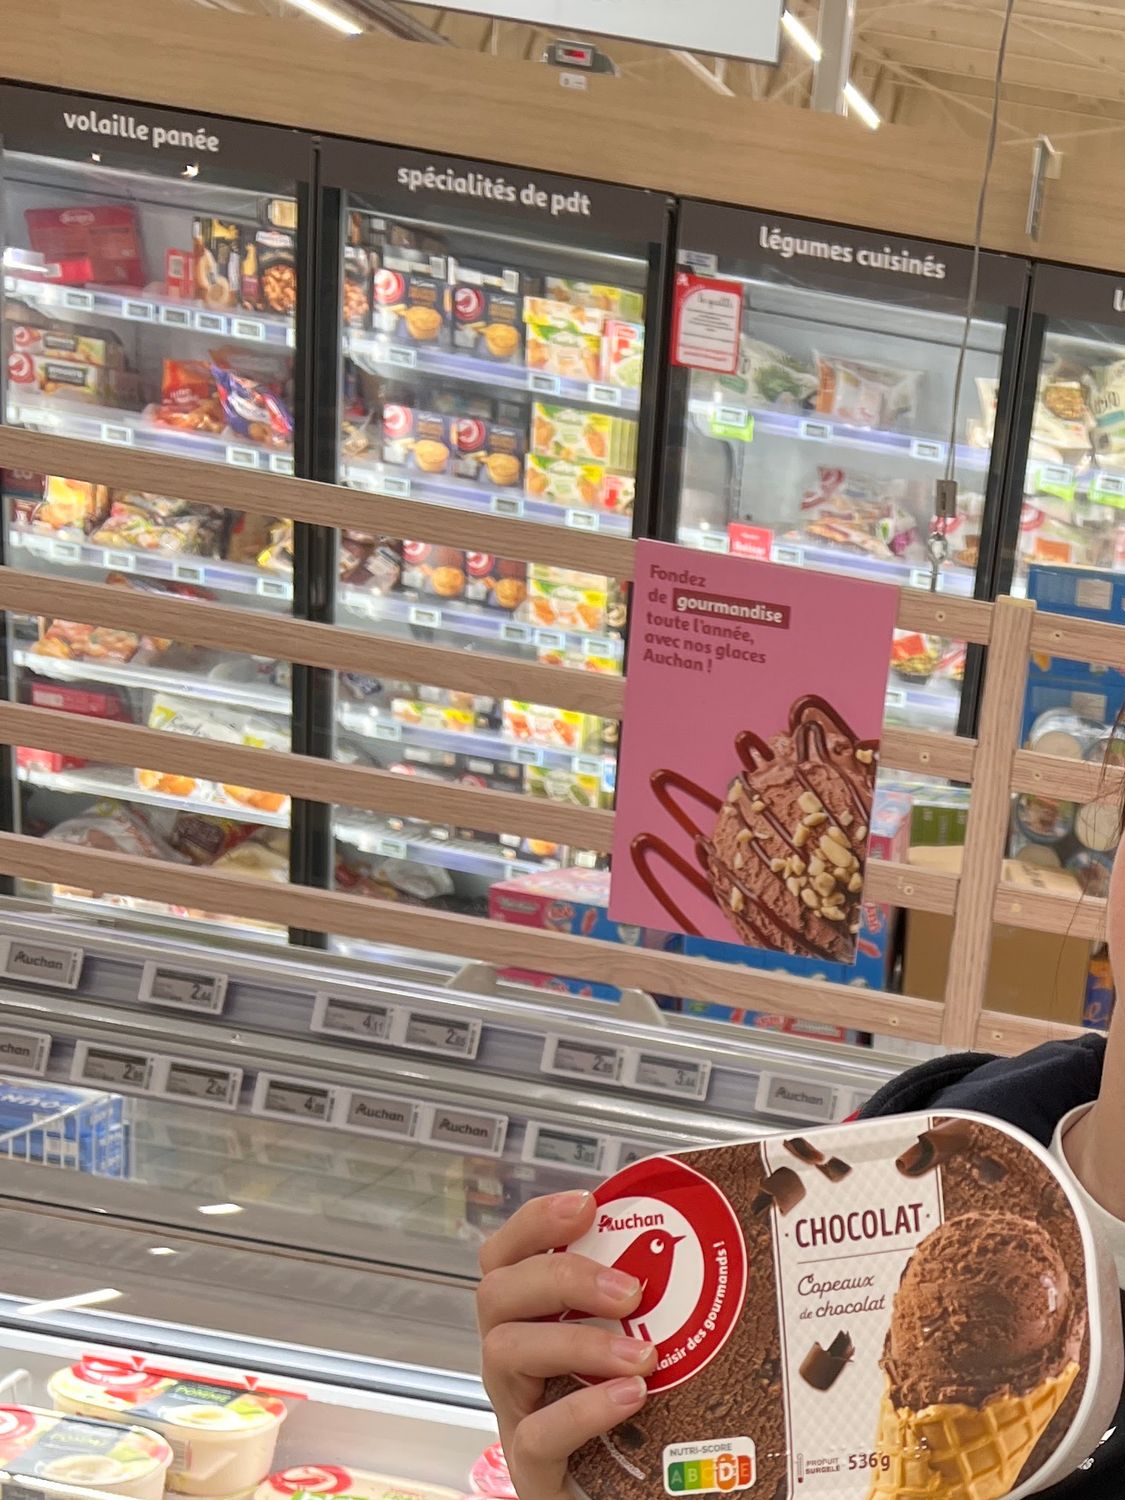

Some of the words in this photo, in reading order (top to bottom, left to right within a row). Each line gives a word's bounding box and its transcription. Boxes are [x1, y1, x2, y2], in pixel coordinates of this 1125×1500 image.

[64, 110, 149, 140] volaille
[152, 127, 220, 152] panée
[397, 166, 517, 201] spécialités
[520, 183, 549, 207] de
[550, 191, 591, 216] pdt
[759, 226, 853, 262] légumes
[856, 246, 946, 279] cuisinés
[650, 564, 706, 588] Fondez
[648, 588, 667, 604] de
[676, 596, 783, 623] gourmandise
[646, 612, 690, 631] toute
[693, 618, 755, 645] l'année,
[644, 631, 680, 648] avec
[683, 639, 712, 654] nos
[715, 643, 767, 664] glaces
[643, 648, 703, 672] Auchan
[707, 659, 713, 673] !
[14, 951, 63, 970] Auchan
[775, 1086, 823, 1105] Auchan
[355, 1103, 404, 1122] Auchan
[438, 1117, 489, 1138] Auchan
[598, 1213, 664, 1233] Auchan
[795, 1203, 923, 1248] CHOCOLAT
[797, 1273, 875, 1299] Copeaux
[655, 1347, 687, 1371] laisir
[686, 1329, 707, 1351] des
[704, 1248, 728, 1331] gourmands
[799, 1307, 813, 1320] de
[815, 1294, 886, 1318] chocolat
[669, 1442, 733, 1457] NUTRI-SCORE
[806, 1457, 840, 1467] PRODUIT
[670, 1470, 683, 1485] A
[687, 1467, 698, 1482] B
[719, 1461, 737, 1482] D
[740, 1461, 750, 1478] E
